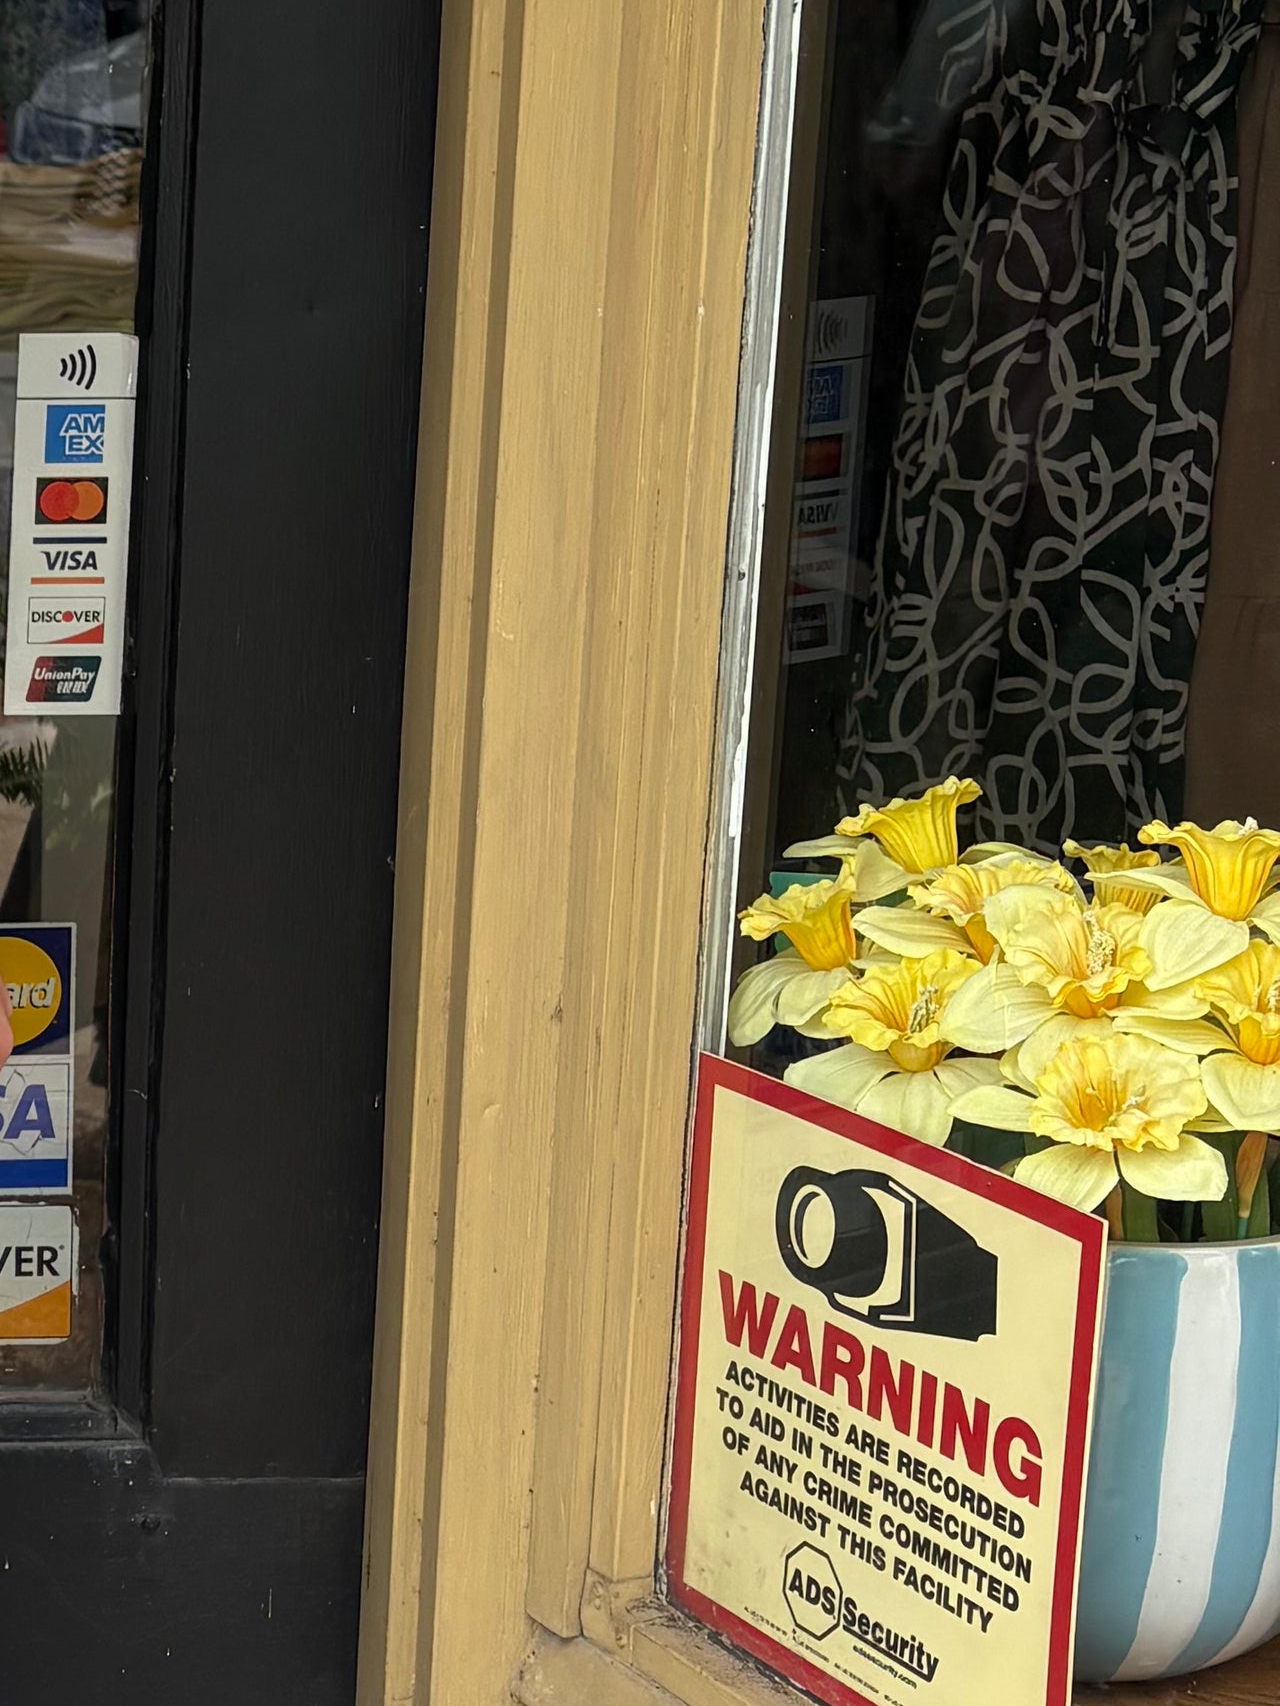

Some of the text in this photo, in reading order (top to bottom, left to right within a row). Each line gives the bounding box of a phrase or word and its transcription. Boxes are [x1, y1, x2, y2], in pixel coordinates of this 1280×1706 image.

[60, 414, 105, 435] AM
[65, 434, 103, 454] EX
[31, 610, 100, 623] DISCOVER
[41, 551, 98, 570] VISA
[34, 667, 96, 685] UnionPay
[719, 1269, 1043, 1507] WARNING
[716, 1387, 1032, 1584] TO AID IN THE PROSECUTION
[725, 1360, 1025, 1540] ACTIVITIES ARE RECORDED
[722, 1426, 1020, 1612] OF ANY CRIME COMMITTED
[740, 1470, 993, 1633] AGAINST THIS FACILITY
[788, 1568, 836, 1616] ADS
[843, 1596, 939, 1683] Security
